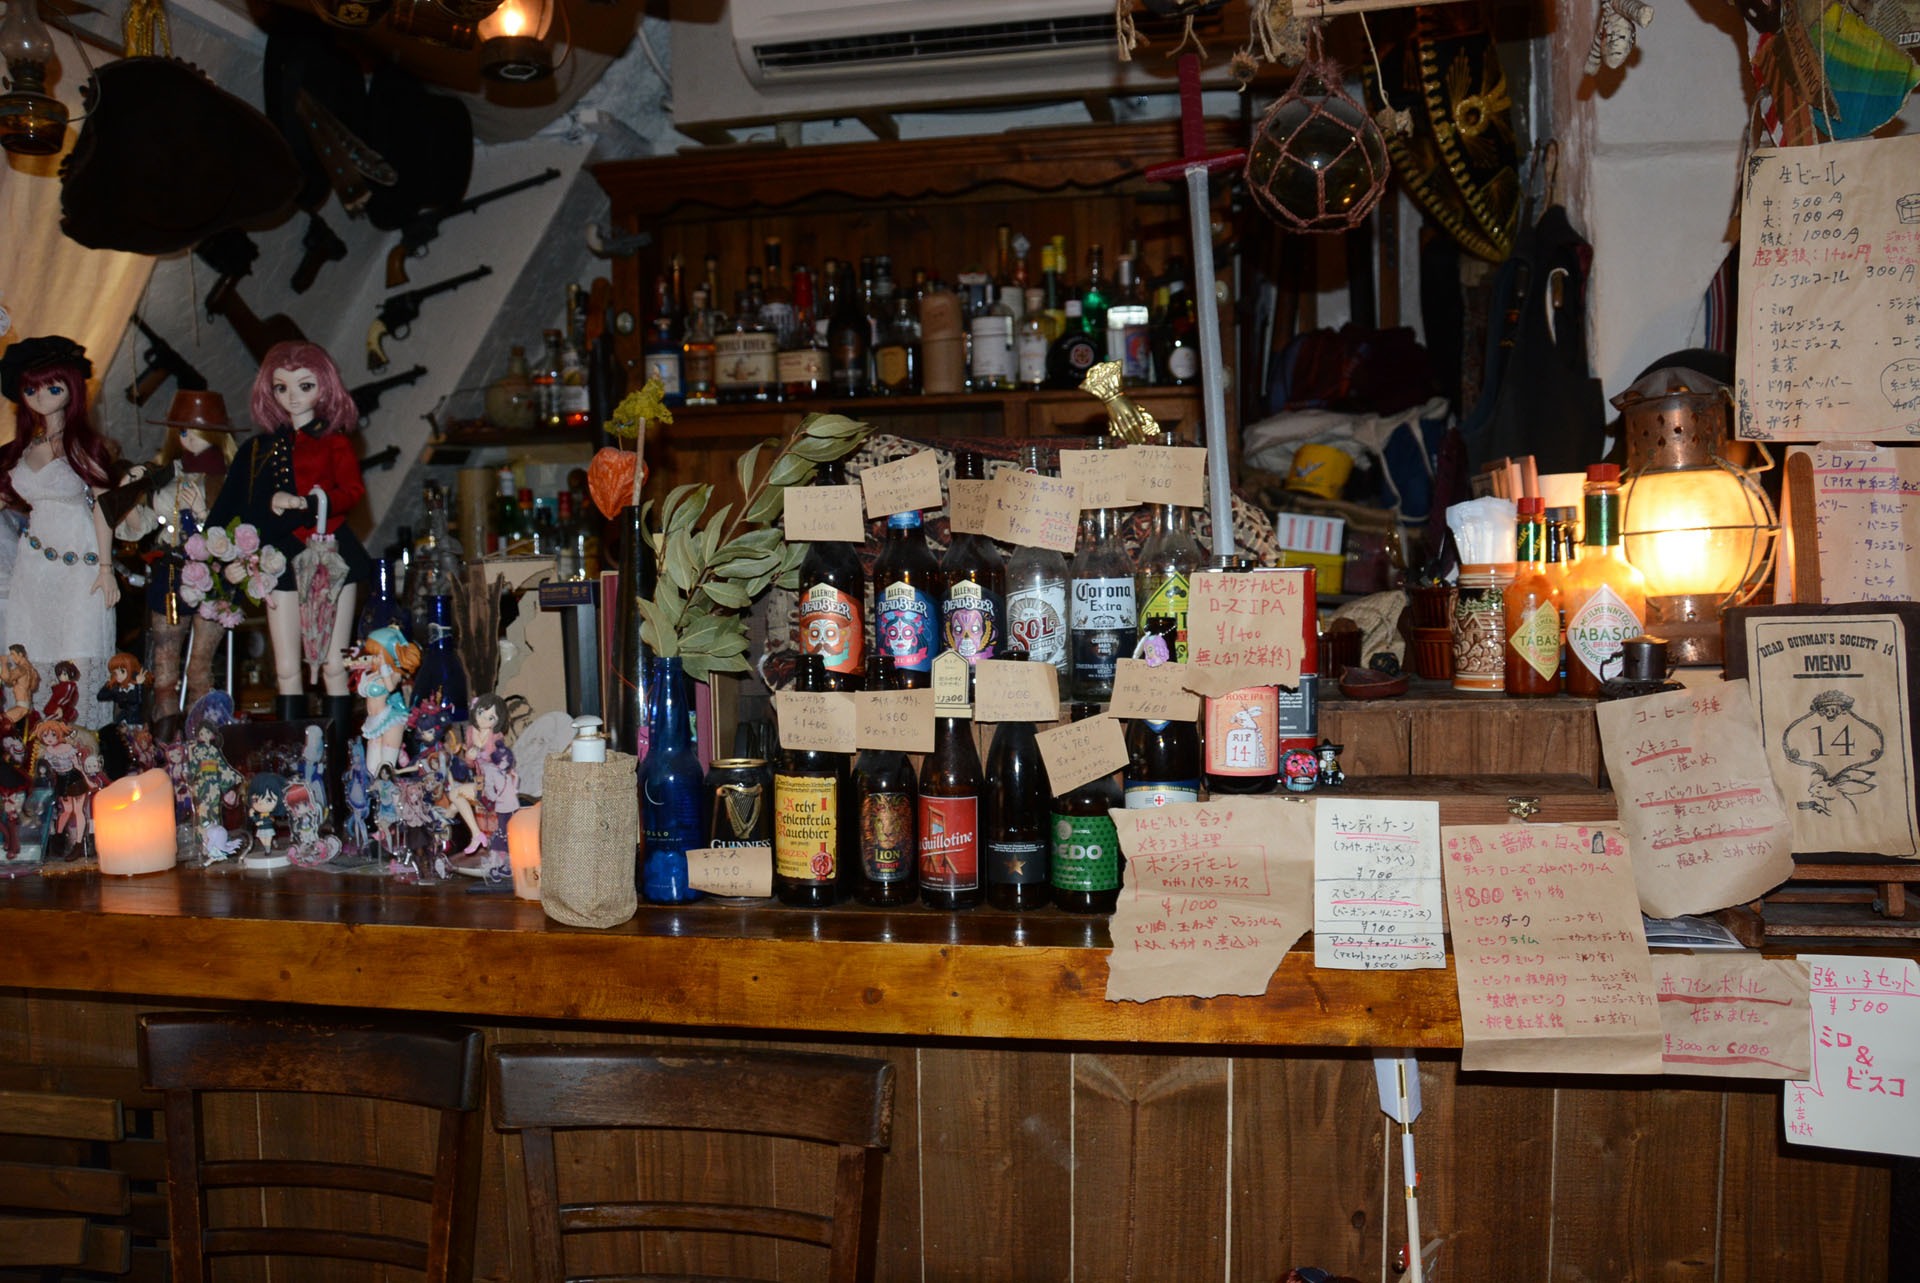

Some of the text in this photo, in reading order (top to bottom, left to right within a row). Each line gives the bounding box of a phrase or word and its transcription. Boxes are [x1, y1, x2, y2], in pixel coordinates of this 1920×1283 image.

[1779, 160, 1845, 186] 生ビール
[1792, 192, 1842, 210] 500円
[1793, 209, 1844, 224] 700円
[1803, 227, 1860, 244] 1000円
[1771, 264, 1915, 288] ノンアルコール 300円
[1771, 303, 1794, 317] ミルク
[1770, 317, 1845, 334] オレンジジュース
[1772, 336, 1841, 352] りんごジュース
[1771, 355, 1797, 373] 麦茶
[1768, 376, 1852, 393] ドクターペッパー
[1766, 397, 1849, 411] マウンテンデュー
[1817, 454, 1878, 471] シロップ
[1870, 500, 1908, 515] 青りんご
[1867, 520, 1900, 532] バニラ
[1866, 558, 1893, 569] ミント
[1199, 576, 1299, 596] 14 オリジナルビール
[1865, 575, 1896, 588] ピーチ
[811, 586, 836, 599] ALLENDE
[887, 585, 913, 598] ALLENDE
[953, 585, 978, 598] ALLENDE
[1076, 582, 1131, 604] Corona
[1090, 600, 1122, 611] Extra
[1210, 597, 1286, 616] ローズ IPA
[1216, 621, 1262, 645] ¥1400
[1572, 626, 1640, 642] TABASCO
[1759, 633, 1894, 658] DEAD GUNMAN'S SOCIETY 14
[1804, 654, 1851, 672] MENU
[1635, 738, 1681, 758] メキシコ
[1810, 724, 1856, 757] 14
[1232, 745, 1252, 762] 14
[784, 797, 817, 813] Aecht
[777, 811, 831, 827] Schlenkerla
[777, 825, 830, 841] Rauchbier
[921, 831, 973, 850] Guillotine
[711, 839, 771, 849] GUINNESS
[1138, 831, 1223, 853] メキシコ料理
[874, 848, 901, 863] LION
[1146, 851, 1240, 875] ポジョデモーレ
[1357, 867, 1393, 881] ¥700
[1464, 864, 1495, 876] テキーラ
[1500, 863, 1532, 875] ローズ
[1191, 874, 1250, 890] バターライス
[1453, 885, 1504, 912] ¥800
[1162, 897, 1218, 918] ¥1000
[1474, 913, 1530, 928] ピンクダーク
[1477, 934, 1540, 946] ピンクライム
[1660, 972, 1767, 994] 赤ワインボトル
[1811, 966, 1915, 993] 強い子セット
[1829, 996, 1889, 1016] ¥500
[1690, 1005, 1769, 1026] 始めました。
[1819, 1026, 1853, 1048] ミロ
[1855, 1046, 1875, 1067] &
[1846, 1066, 1906, 1098] ビスコ
